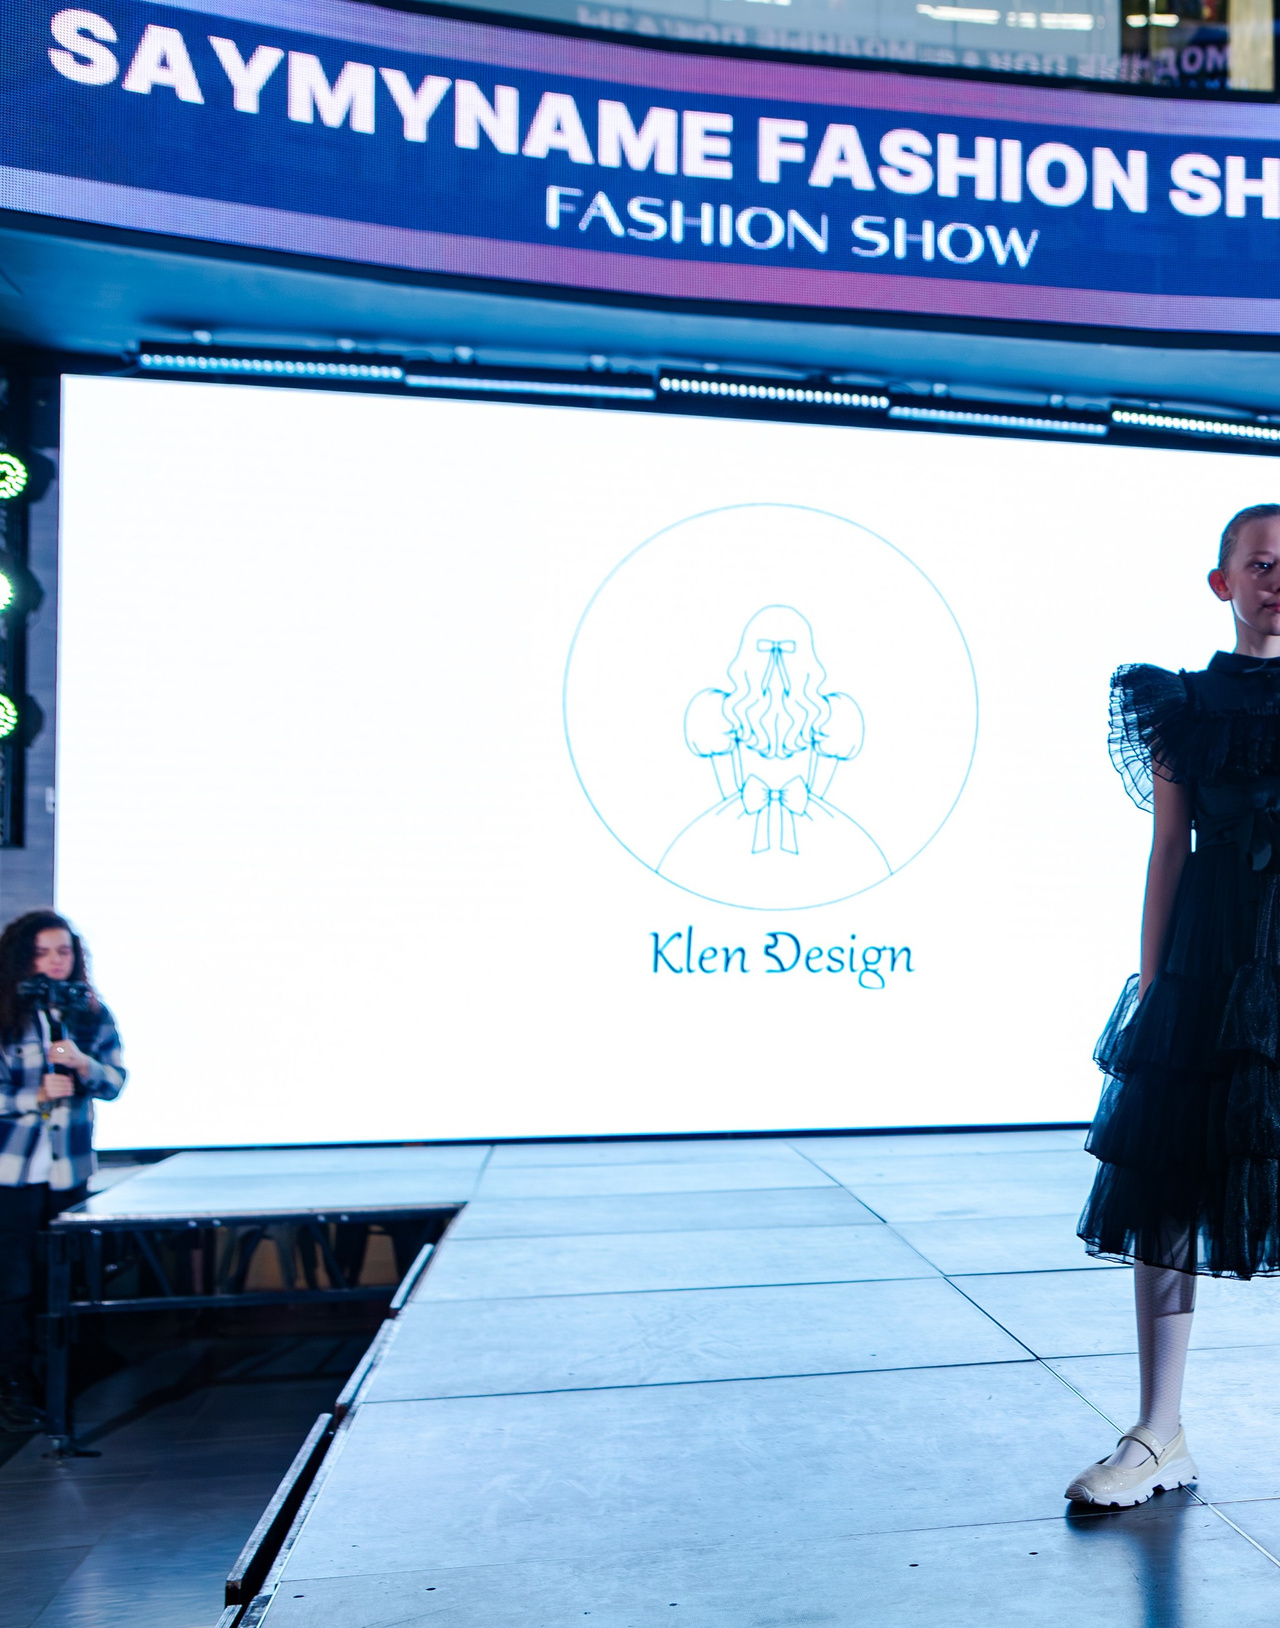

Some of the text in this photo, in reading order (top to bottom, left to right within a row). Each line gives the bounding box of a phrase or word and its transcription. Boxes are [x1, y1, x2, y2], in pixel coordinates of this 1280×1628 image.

[48, 11, 733, 179] SAYMYNAME
[758, 117, 1147, 212] FASHION
[545, 186, 1038, 267] FASHION SHOW
[650, 925, 915, 989] Klen Design
